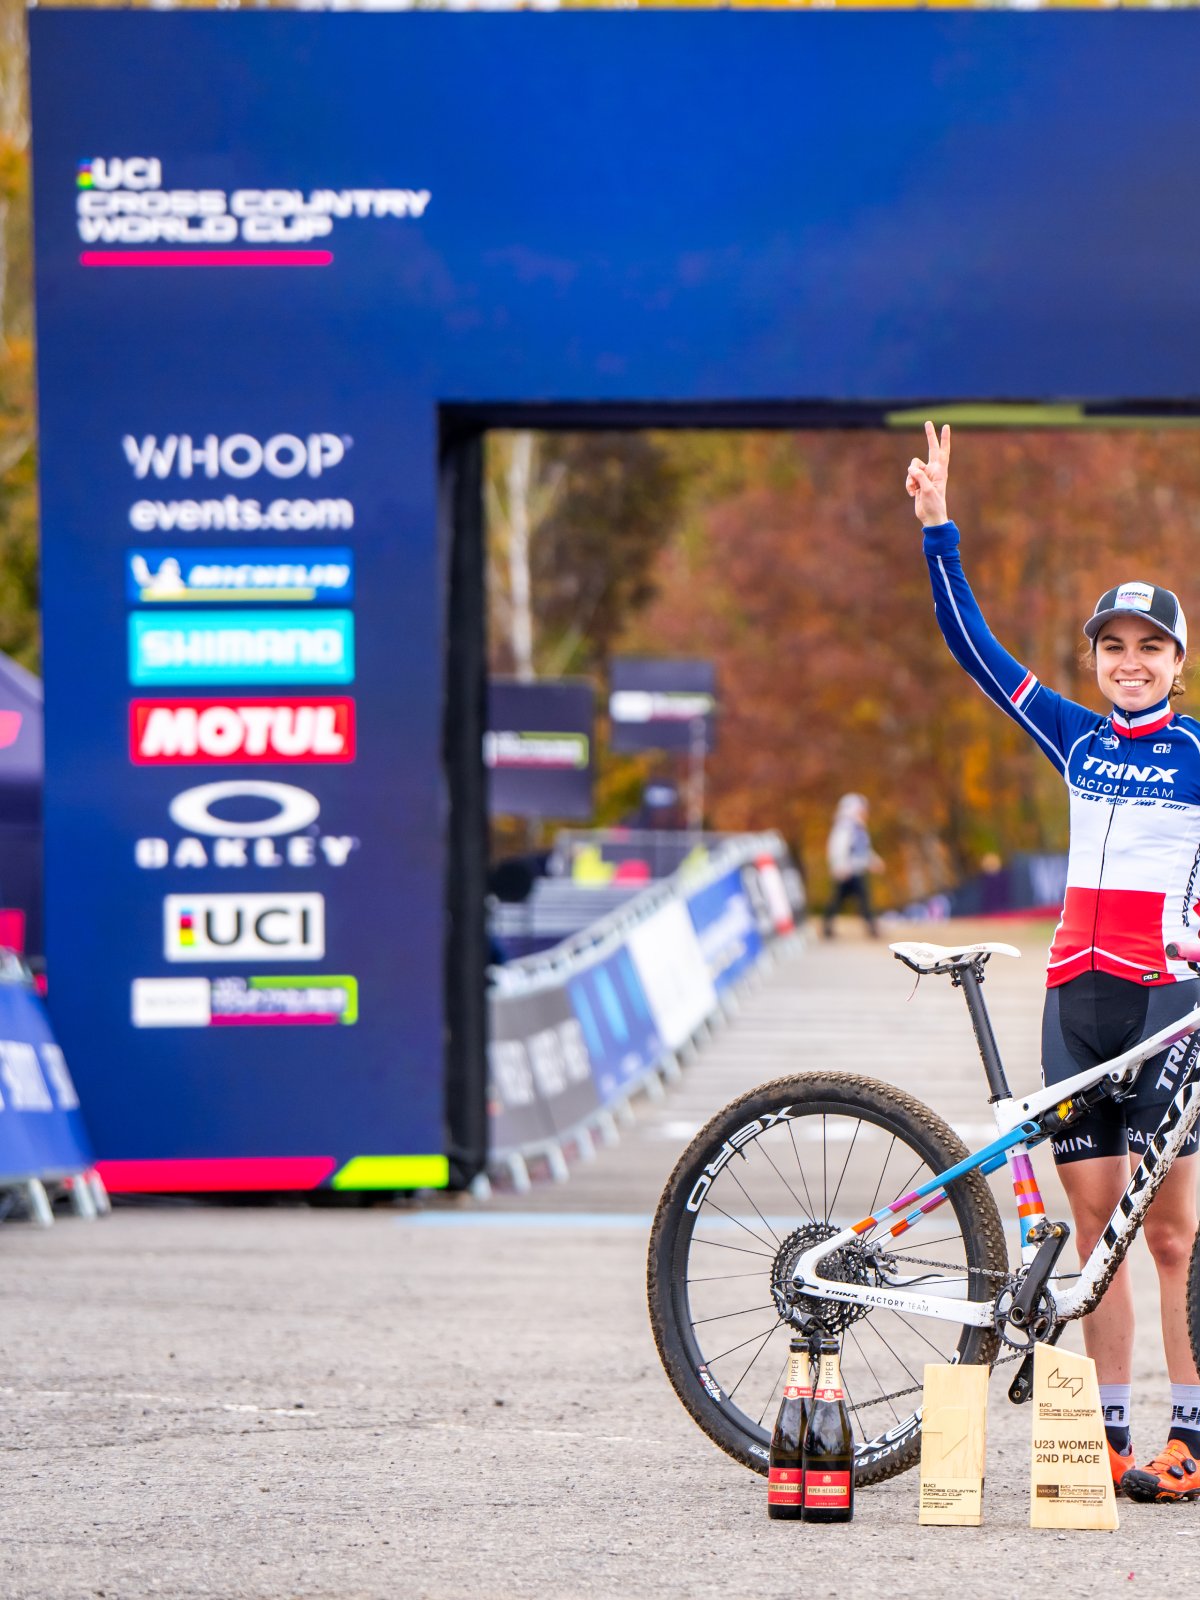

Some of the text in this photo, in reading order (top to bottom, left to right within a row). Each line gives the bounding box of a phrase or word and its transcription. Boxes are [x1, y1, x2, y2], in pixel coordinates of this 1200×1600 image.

[90, 157, 161, 190] UCI
[77, 190, 431, 217] CROSS COUNTRY
[78, 216, 333, 242] WORLD CUP
[123, 433, 345, 479] WHOOP
[129, 494, 354, 532] events.com
[188, 565, 350, 588] MICHELIN
[141, 629, 343, 667] SHIMANO
[140, 706, 344, 756] MOTUL
[1082, 754, 1179, 784] TRINX
[1076, 775, 1129, 795] FACTORY
[1135, 787, 1174, 798] TEAM
[135, 837, 353, 868] OAKLEY
[204, 909, 310, 946] UCI
[686, 1105, 794, 1213] XERO
[824, 1289, 930, 1313] TRINX FACTORY TEAM
[790, 1359, 799, 1382] PIPER
[824, 1361, 834, 1385] PIPER
[871, 1434, 909, 1462] JACK
[1034, 1439, 1103, 1450] U23 WOMEN
[1036, 1453, 1100, 1464] 2ND PLACE
